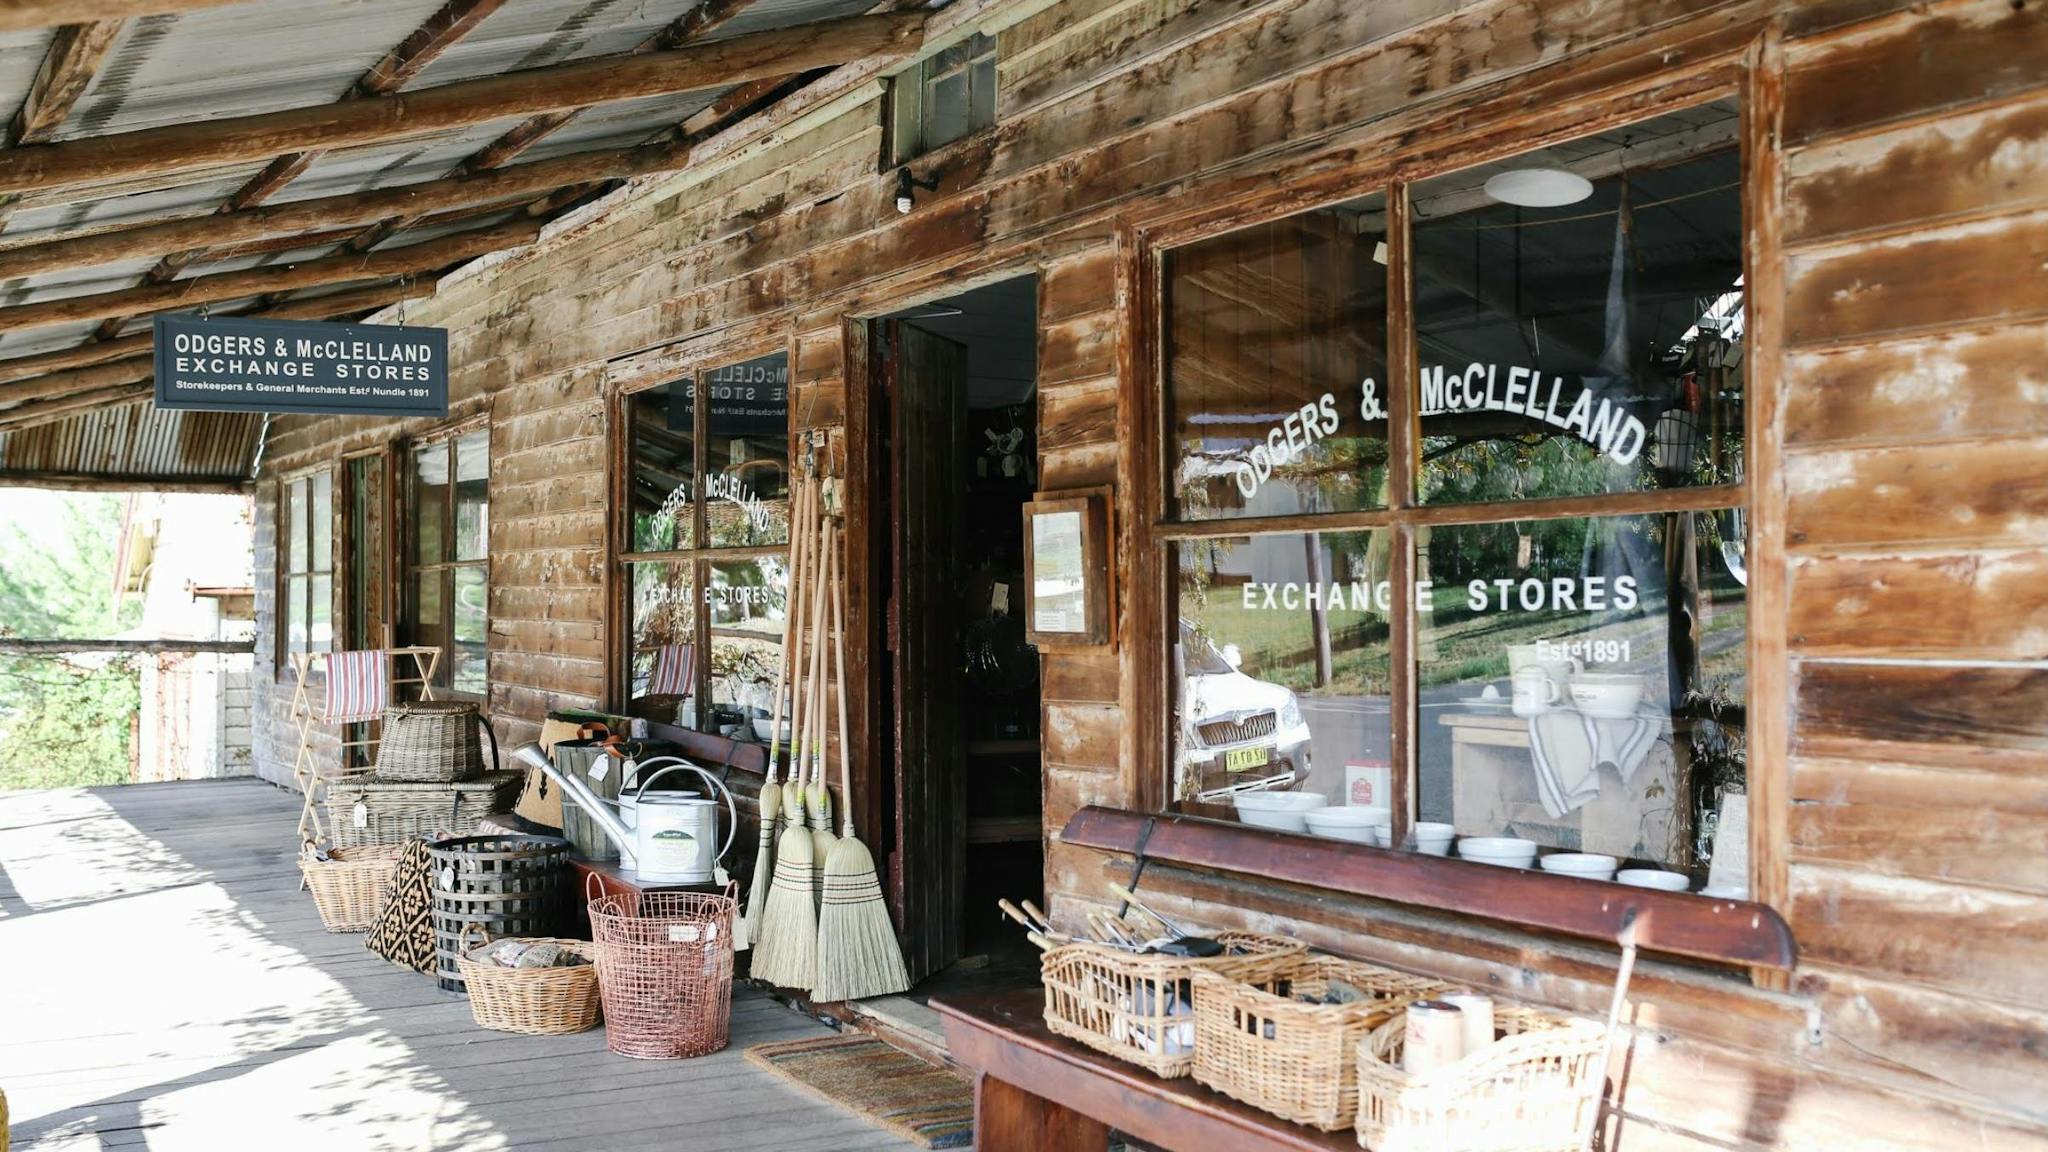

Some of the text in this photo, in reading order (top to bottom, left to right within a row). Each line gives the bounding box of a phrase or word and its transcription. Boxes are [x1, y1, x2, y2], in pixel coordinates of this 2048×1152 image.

[174, 333, 432, 363] ODGERS & McCLELLAND
[176, 357, 430, 381] EXCHANGE STORES
[176, 380, 243, 393] Storekeepers
[245, 383, 254, 392] &
[256, 383, 294, 393] General
[296, 384, 347, 395] Merchants
[372, 387, 406, 397] Nundle
[408, 388, 430, 397] 1891
[1236, 362, 1646, 499] ODGERS & McCLELLAND
[651, 473, 770, 540] ODGERS McCLELLAND
[652, 586, 770, 604] EXCHANE STORES
[1468, 575, 1638, 612] STORES
